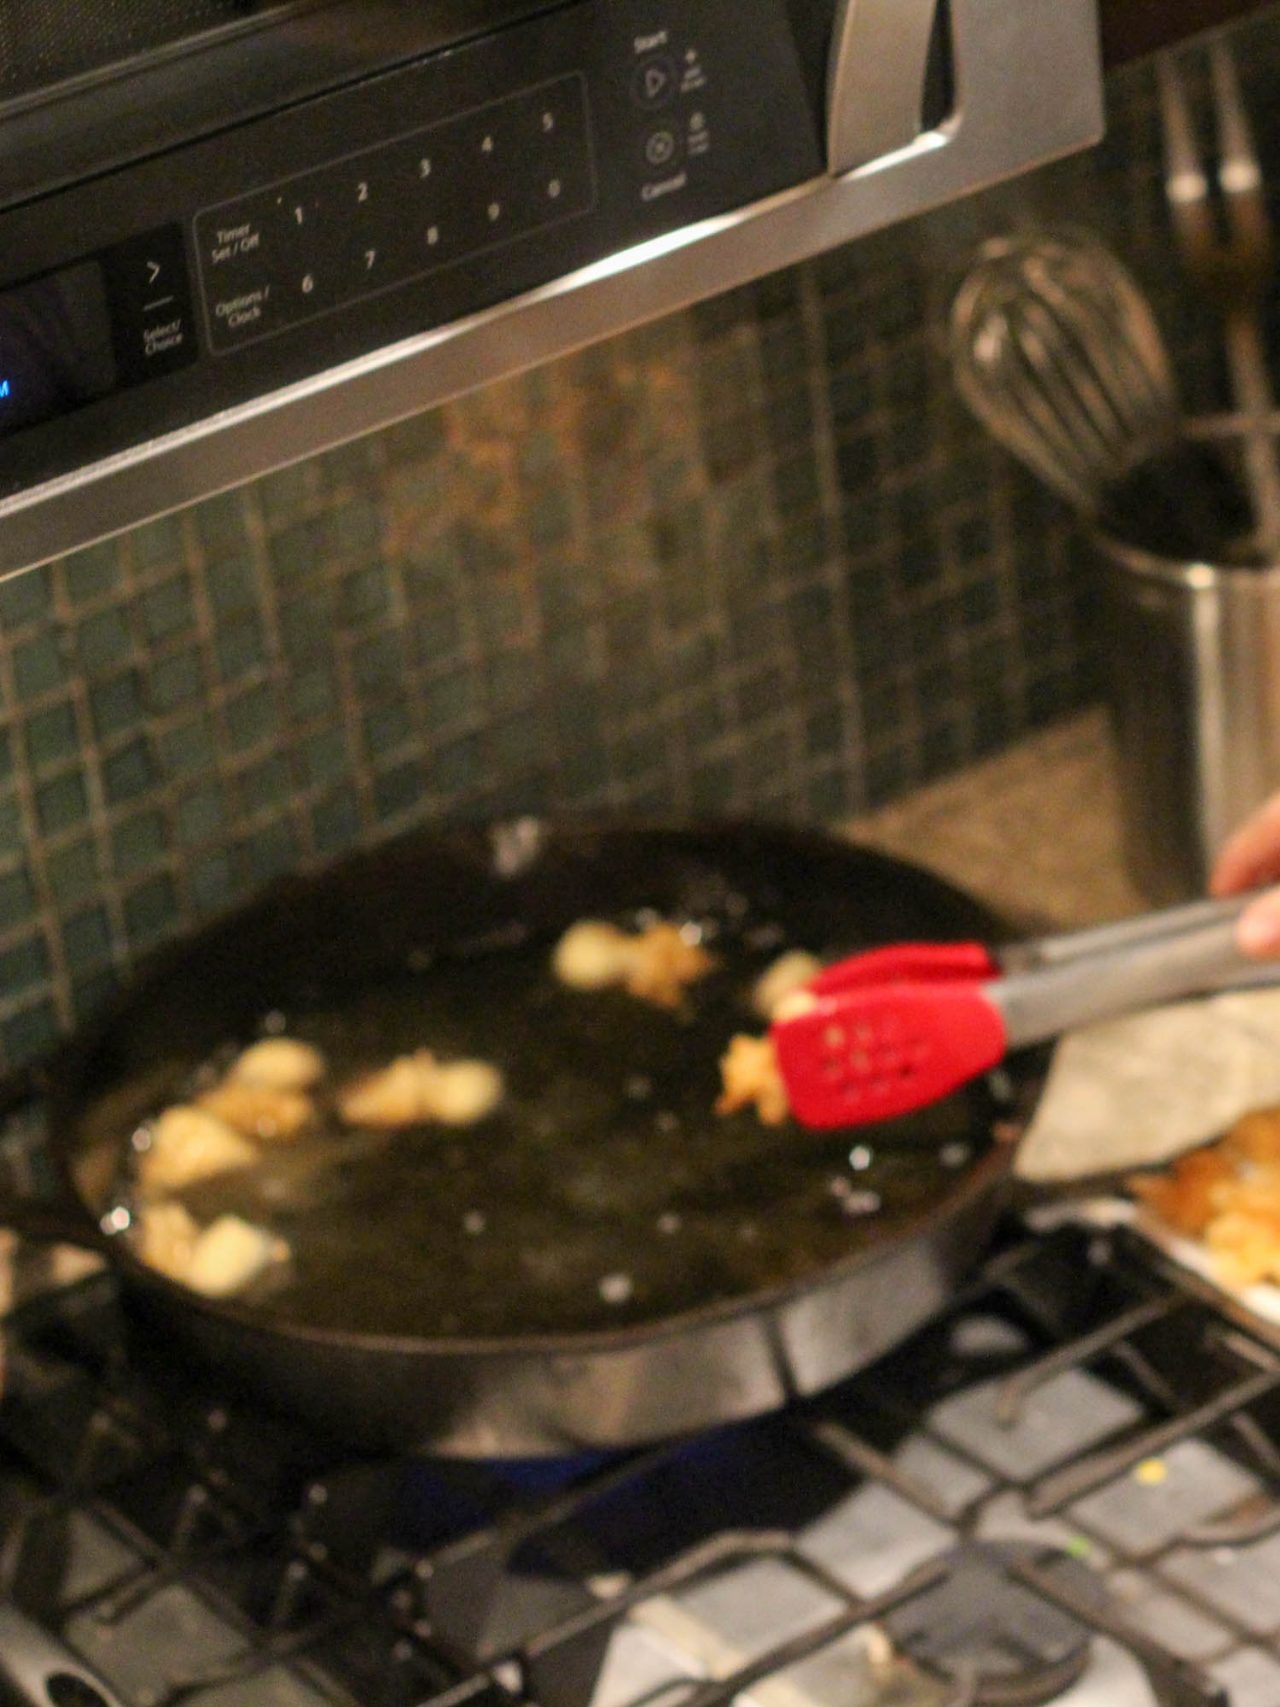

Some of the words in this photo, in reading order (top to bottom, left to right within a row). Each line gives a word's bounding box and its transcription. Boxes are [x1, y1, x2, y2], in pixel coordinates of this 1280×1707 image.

[542, 112, 554, 131] 5
[481, 135, 494, 153] 4
[419, 158, 432, 178] 3
[357, 181, 369, 202] 2
[295, 206, 303, 225] 1
[364, 249, 376, 270] 7
[302, 273, 314, 294] 6
